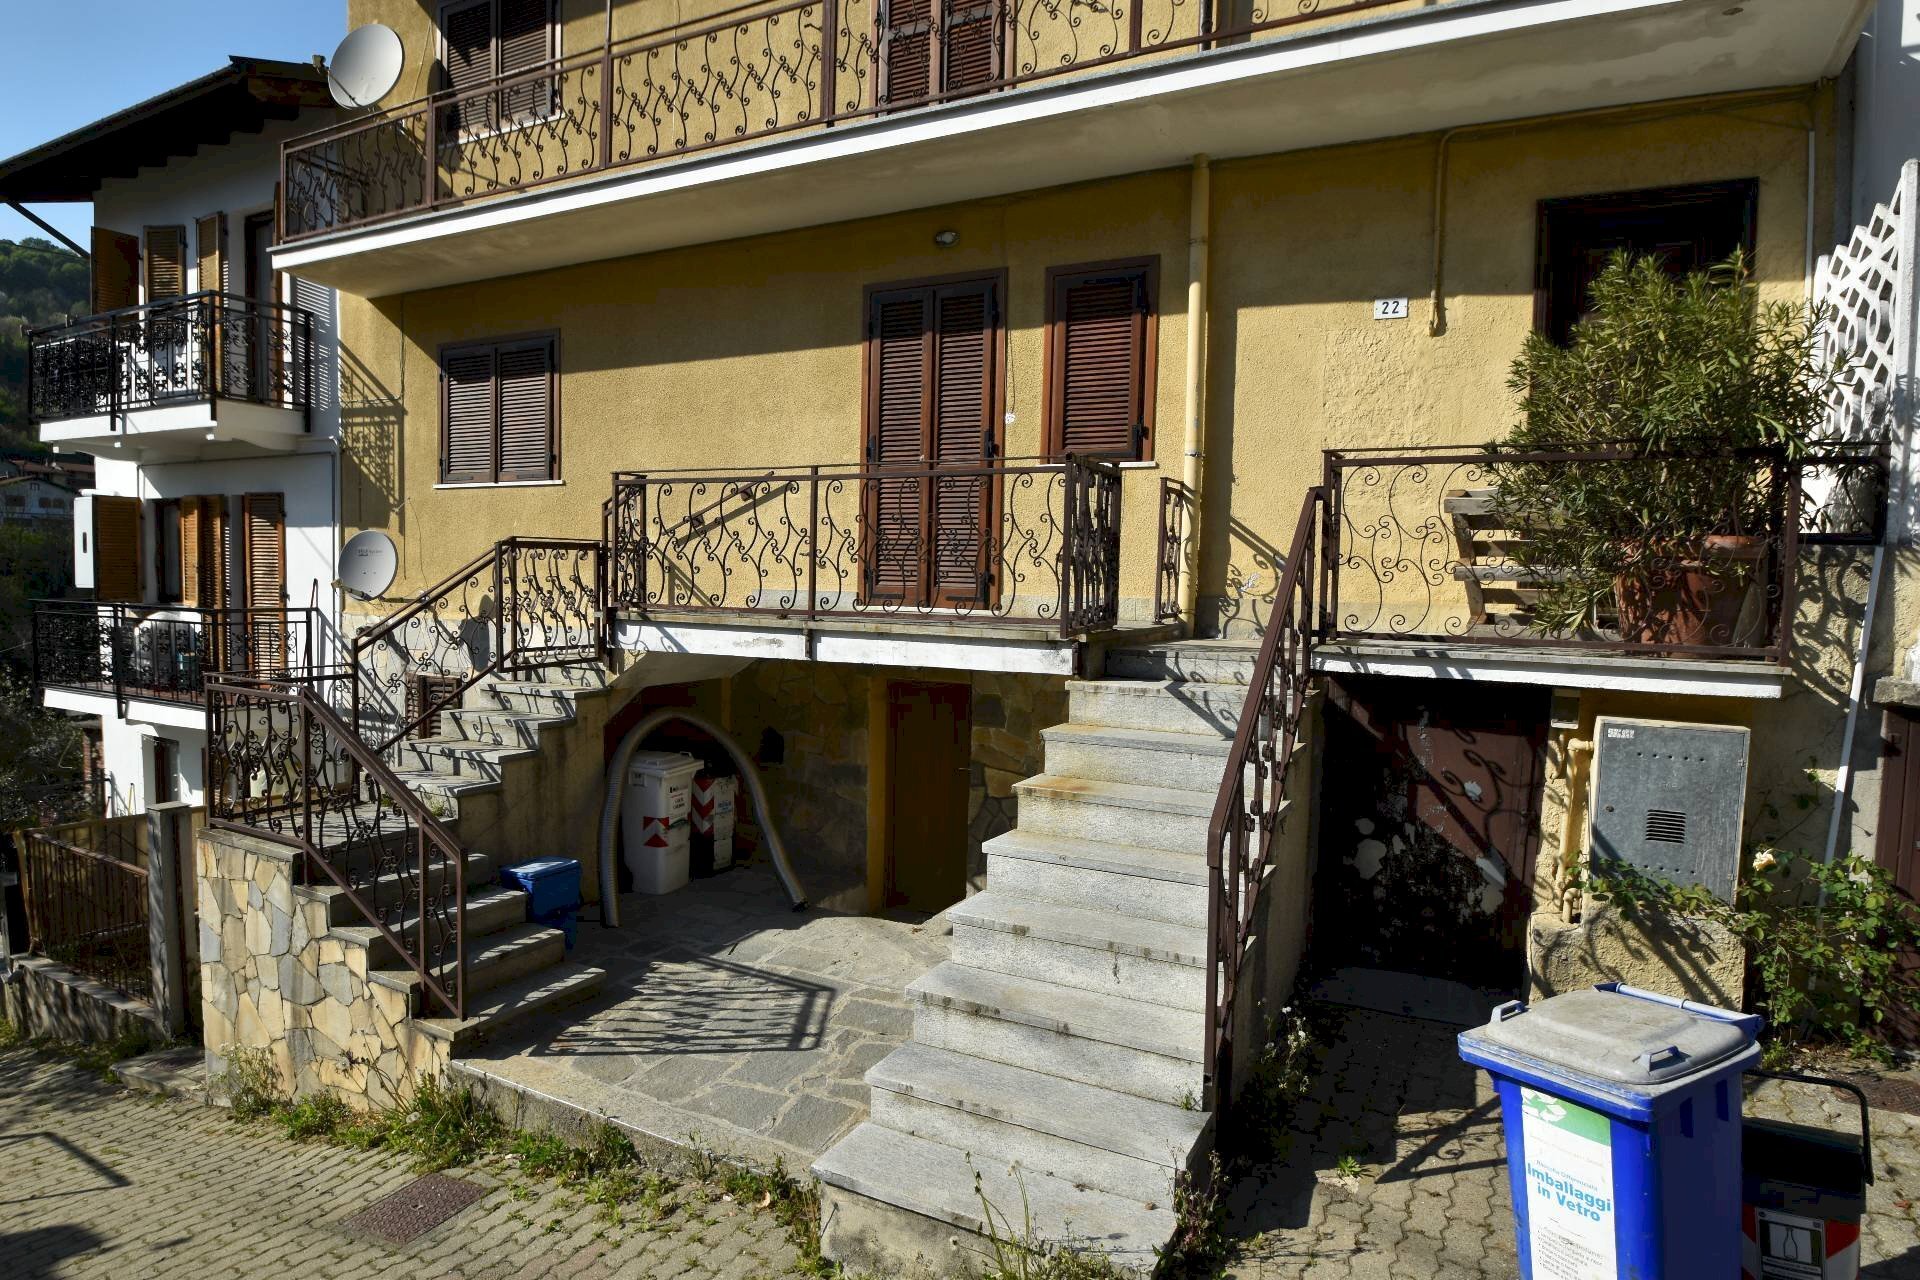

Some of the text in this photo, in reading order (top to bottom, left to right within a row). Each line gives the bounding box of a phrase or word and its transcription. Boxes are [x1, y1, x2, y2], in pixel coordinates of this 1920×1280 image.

[1382, 301, 1400, 315] 22
[1527, 1162, 1611, 1212] Imballaggi
[1537, 1182, 1601, 1222] in Vetro
